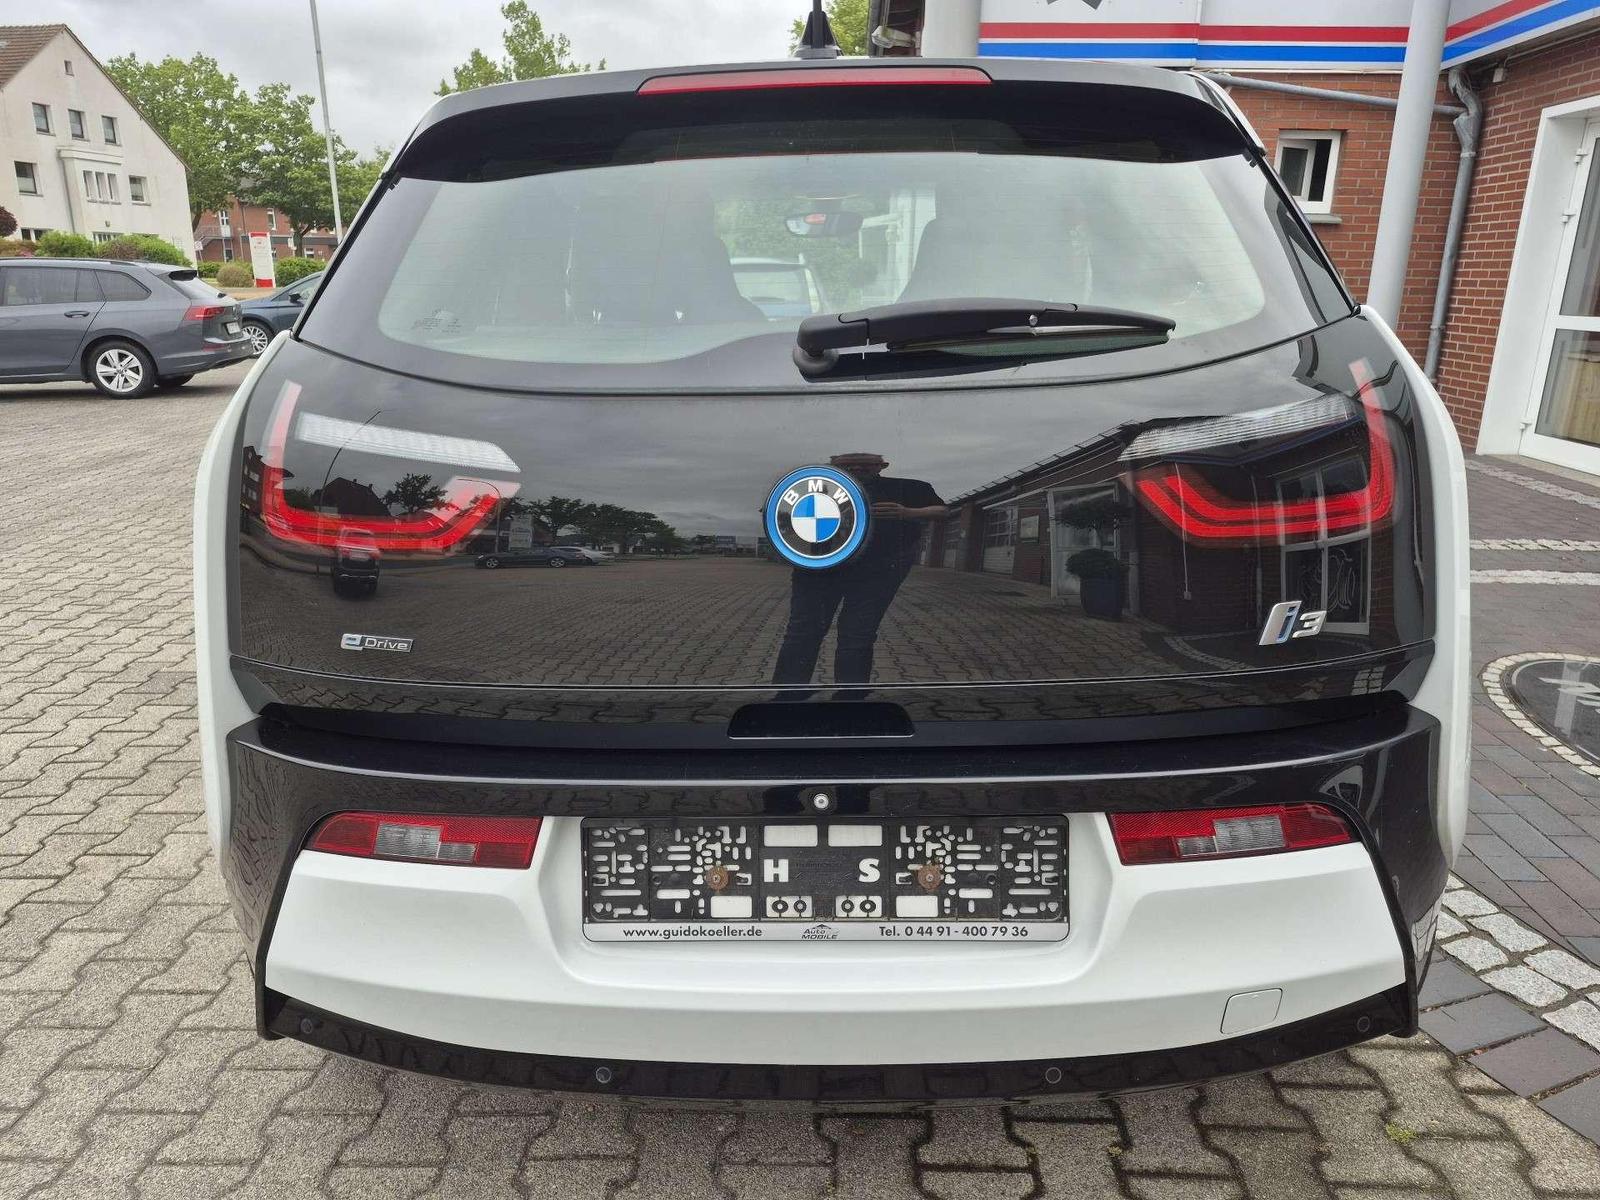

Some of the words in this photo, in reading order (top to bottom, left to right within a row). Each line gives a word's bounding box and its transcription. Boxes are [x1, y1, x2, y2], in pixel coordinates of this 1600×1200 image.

[783, 479, 849, 505] BMW
[623, 925, 763, 939] www.guidokoeller.de
[879, 925, 901, 937] Tel.
[904, 926, 914, 937] 0
[916, 926, 933, 937] 44
[936, 926, 951, 937] 91
[962, 926, 988, 937] 400
[991, 926, 1008, 937] 79
[1011, 926, 1029, 937] 36
